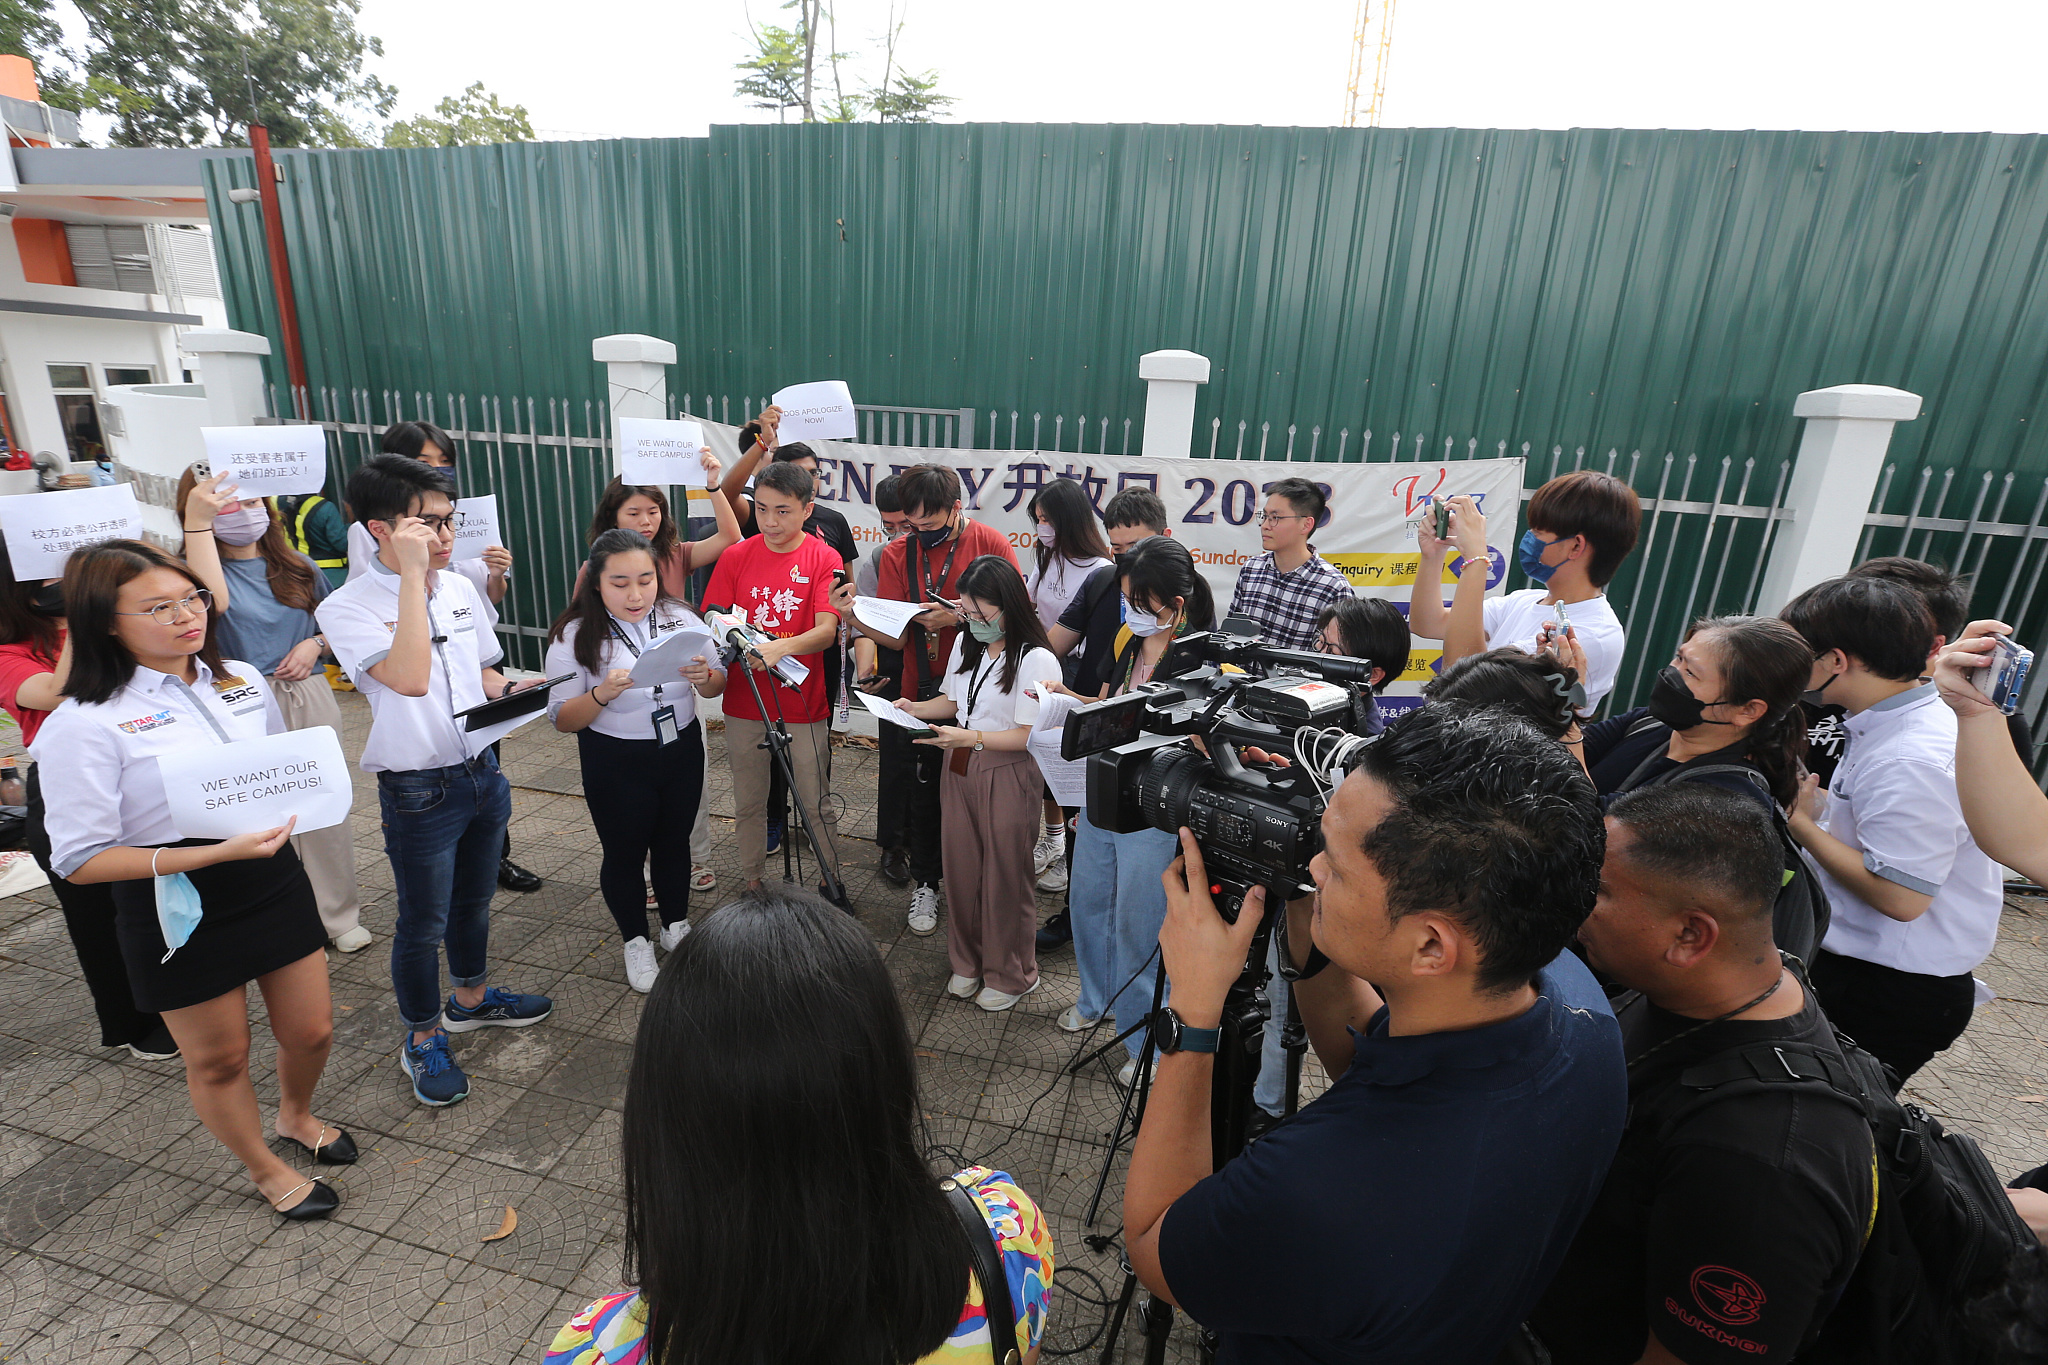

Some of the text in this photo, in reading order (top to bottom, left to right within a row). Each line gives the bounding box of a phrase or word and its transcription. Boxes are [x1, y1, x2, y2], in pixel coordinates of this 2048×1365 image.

[783, 405, 843, 417] DOS APOLOGIZE
[637, 439, 694, 449] WE WANT OUR
[231, 452, 308, 464] 还受害者属于
[637, 450, 694, 459] SAFE CAMPUS!
[1189, 547, 1252, 566] Sunda
[1333, 562, 1384, 578] Enquiry
[749, 586, 772, 600] 青年
[452, 607, 472, 618] SRC
[658, 619, 685, 630] SRC
[221, 686, 259, 703] SRC
[201, 760, 319, 794] WE WANT OUR
[204, 776, 323, 811] SAFE CAMPUS!
[1264, 815, 1289, 828] SONY
[1262, 839, 1283, 852] 4K
[1664, 1297, 1768, 1356] SUKHOI
